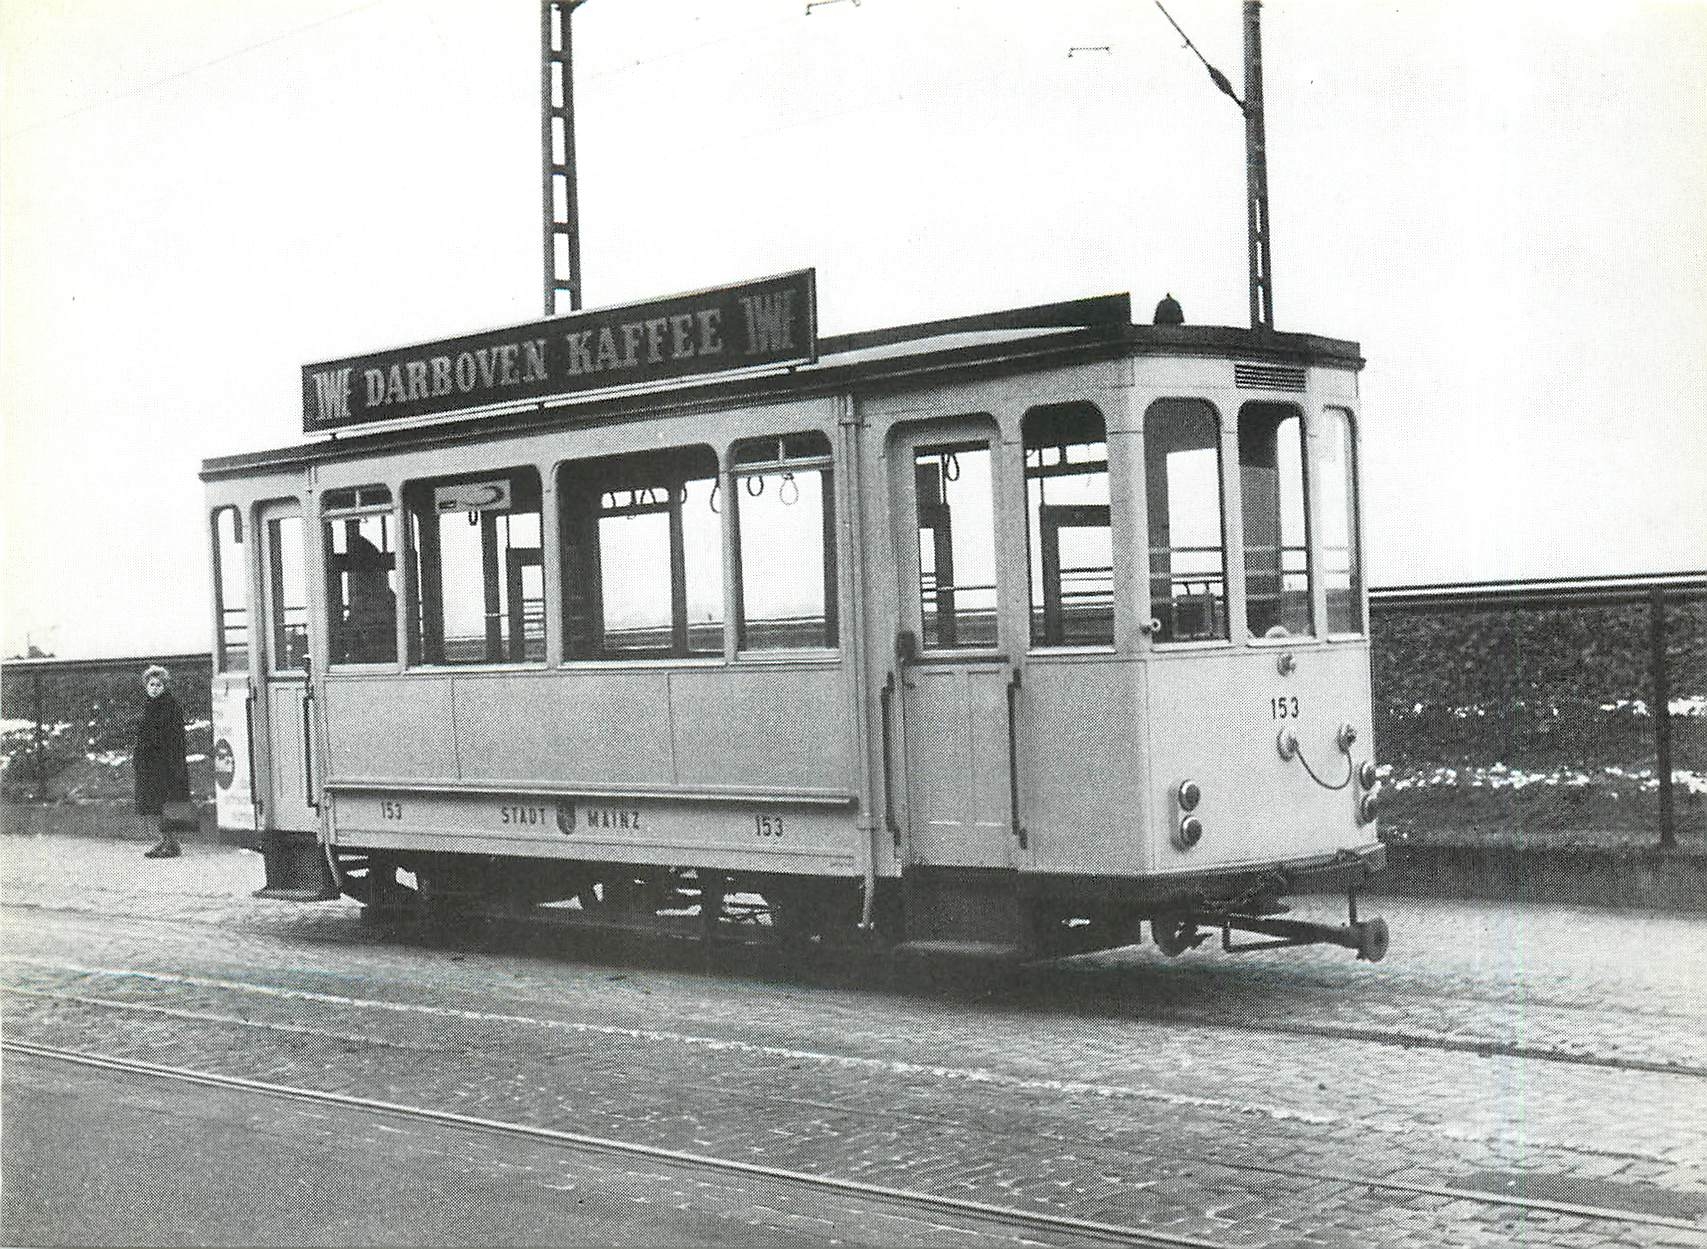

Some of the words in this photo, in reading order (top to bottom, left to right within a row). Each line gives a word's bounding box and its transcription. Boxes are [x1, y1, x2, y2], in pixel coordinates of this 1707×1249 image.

[363, 339, 549, 408] DARBOVEN
[565, 308, 723, 376] KAFFEE
[1271, 697, 1299, 719] 153
[381, 801, 403, 820] 153
[501, 806, 546, 825] STADT
[587, 809, 640, 829] MAINZ
[755, 815, 783, 837] 153
